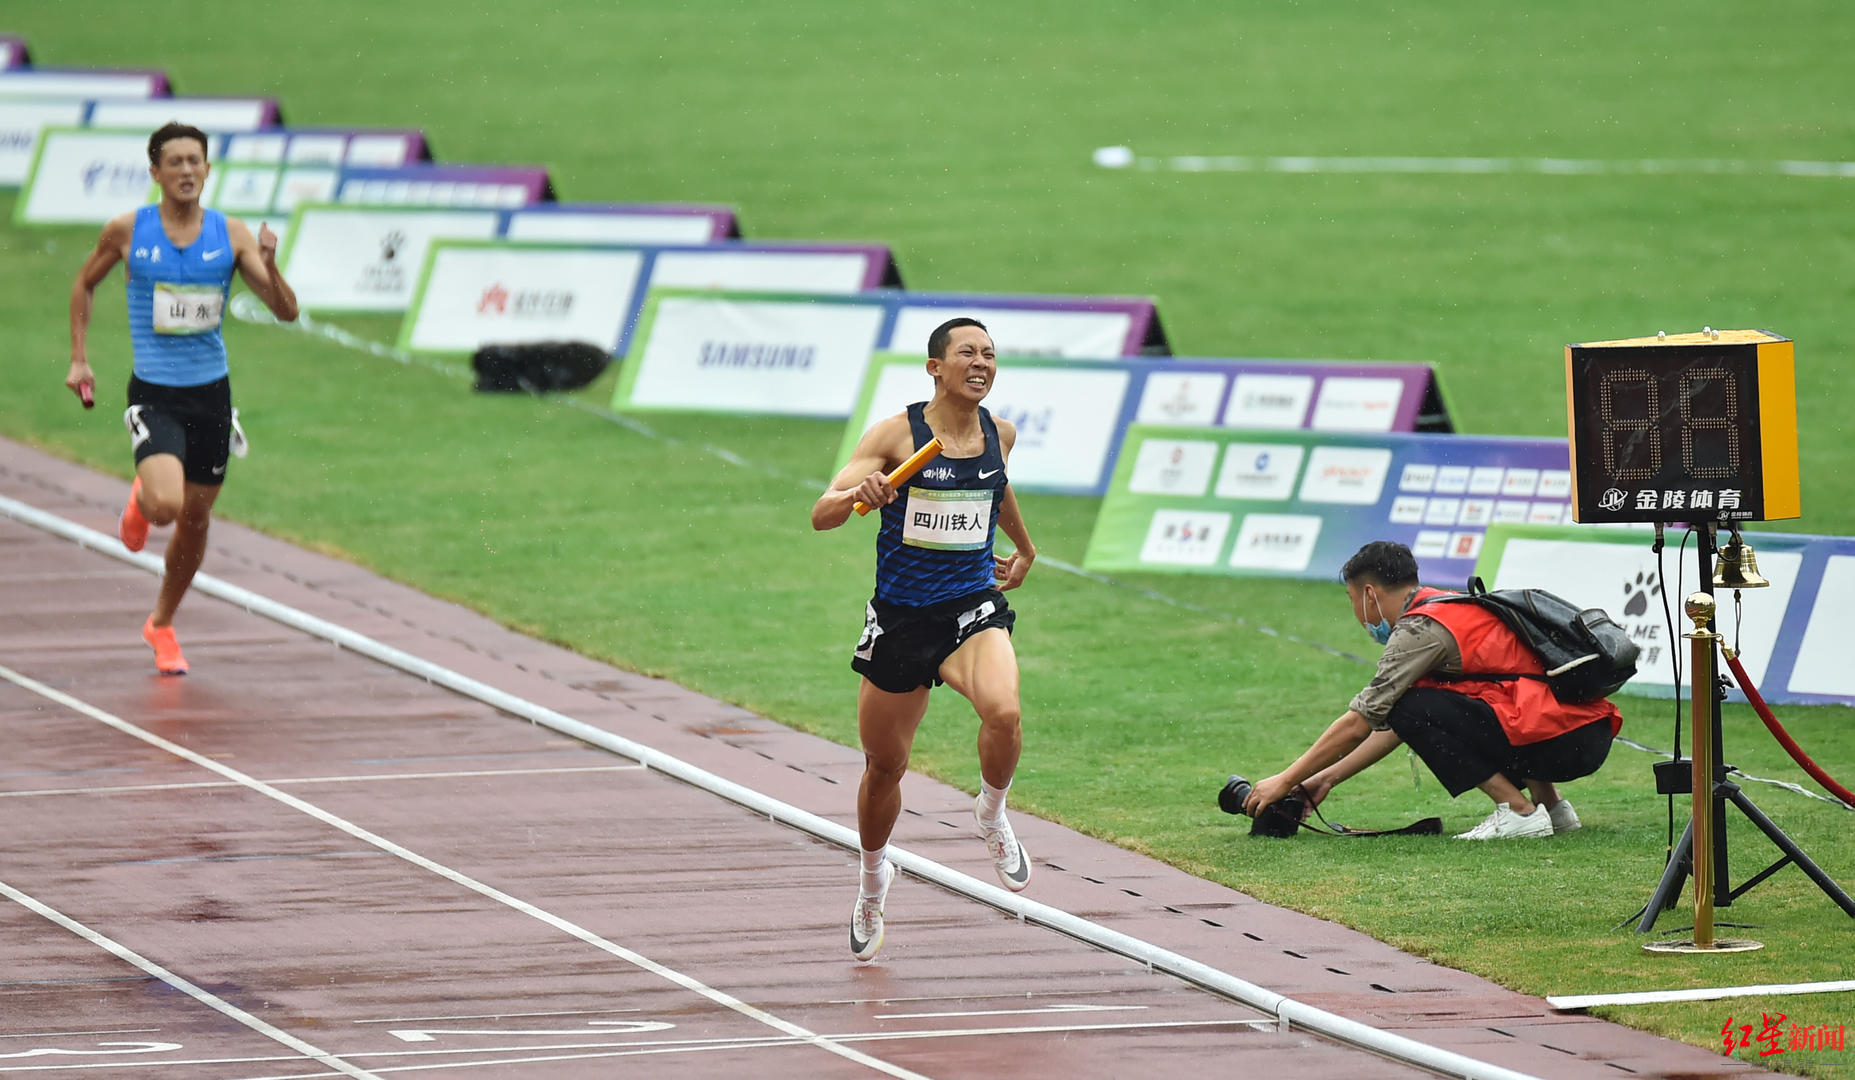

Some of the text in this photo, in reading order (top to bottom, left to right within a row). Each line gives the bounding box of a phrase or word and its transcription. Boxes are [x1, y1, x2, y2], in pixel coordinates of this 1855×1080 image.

[170, 302, 210, 319] 山东
[697, 341, 816, 369] SAMSUNG
[1634, 489, 1742, 510] 金陵体育
[913, 511, 983, 531] 四川铁人
